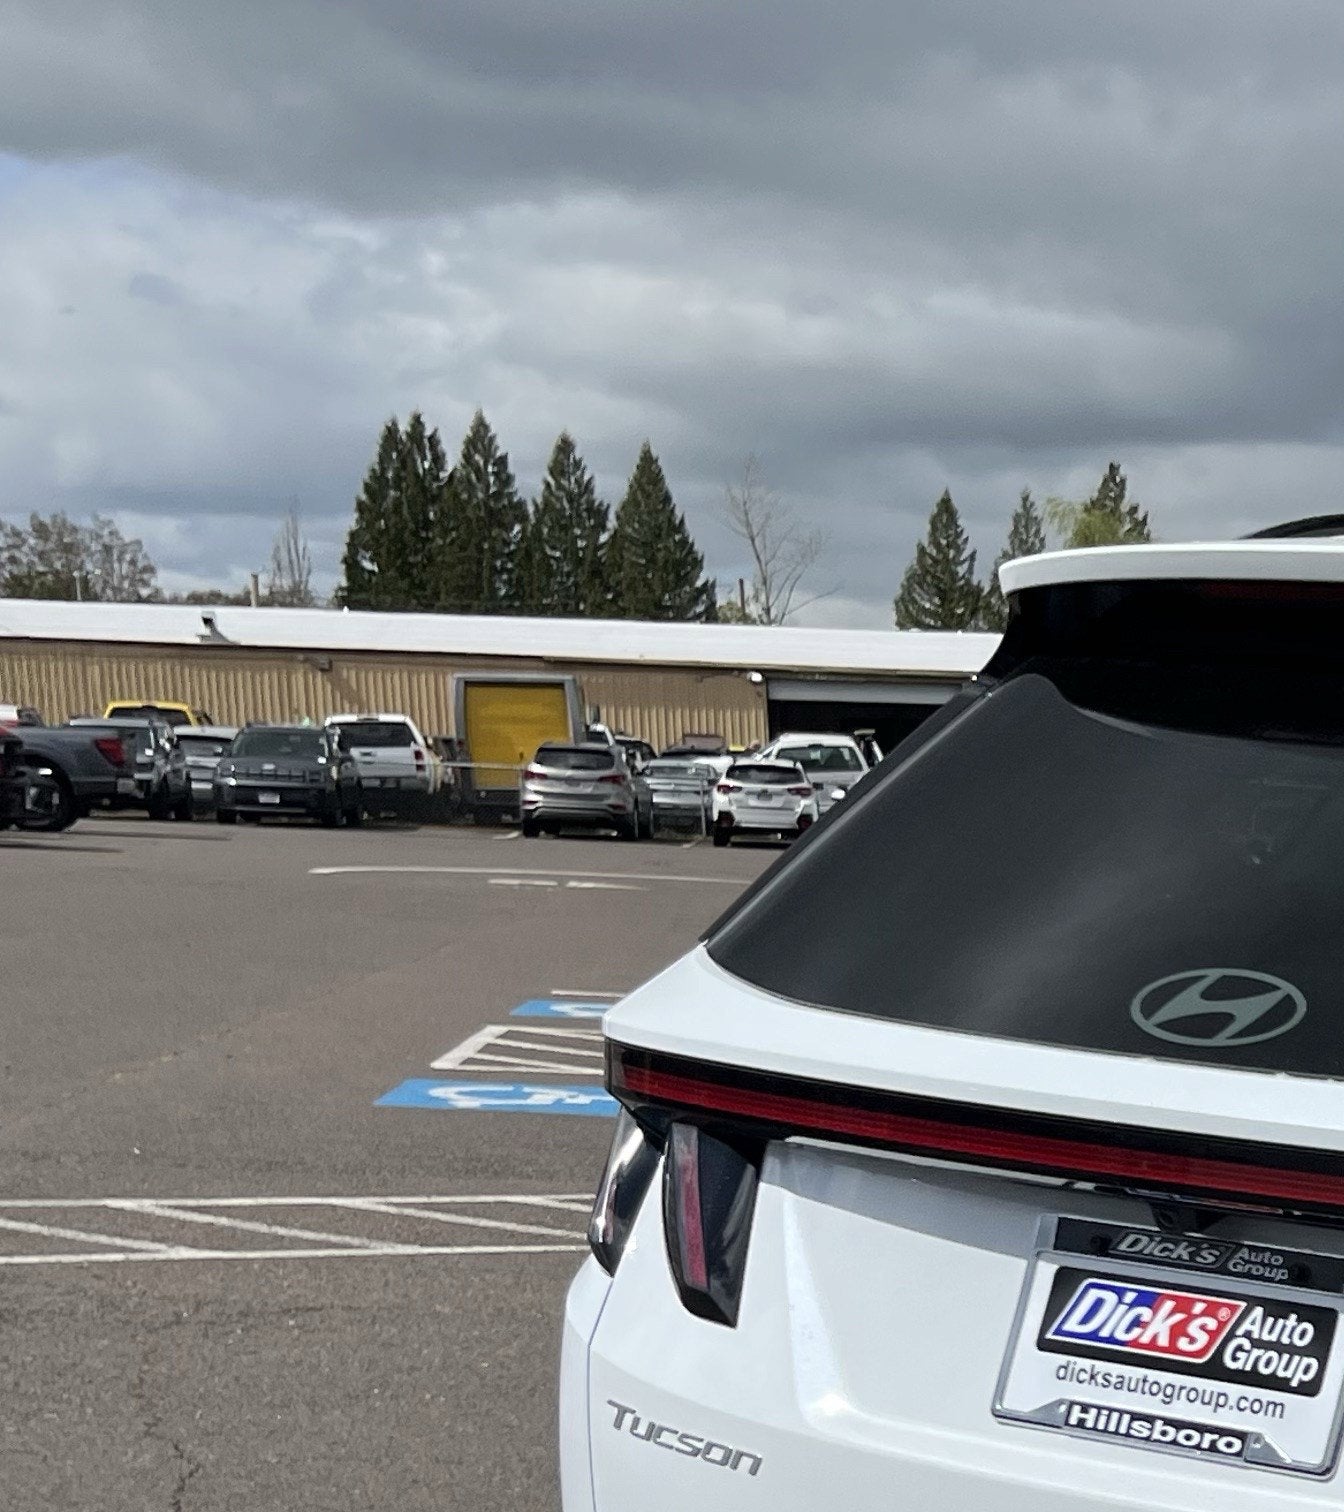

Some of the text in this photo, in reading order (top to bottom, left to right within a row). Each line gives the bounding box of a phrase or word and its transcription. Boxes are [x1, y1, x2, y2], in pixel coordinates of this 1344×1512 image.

[1116, 1233, 1285, 1265] Dick's Auto
[1227, 1259, 1289, 1281] Group
[1062, 1288, 1315, 1353] Dick's Auto
[1222, 1336, 1320, 1388] Group
[1055, 1360, 1286, 1419] dicksautogroup.com
[606, 1399, 763, 1476] Tucson
[1066, 1403, 1243, 1455] Hillsboro
